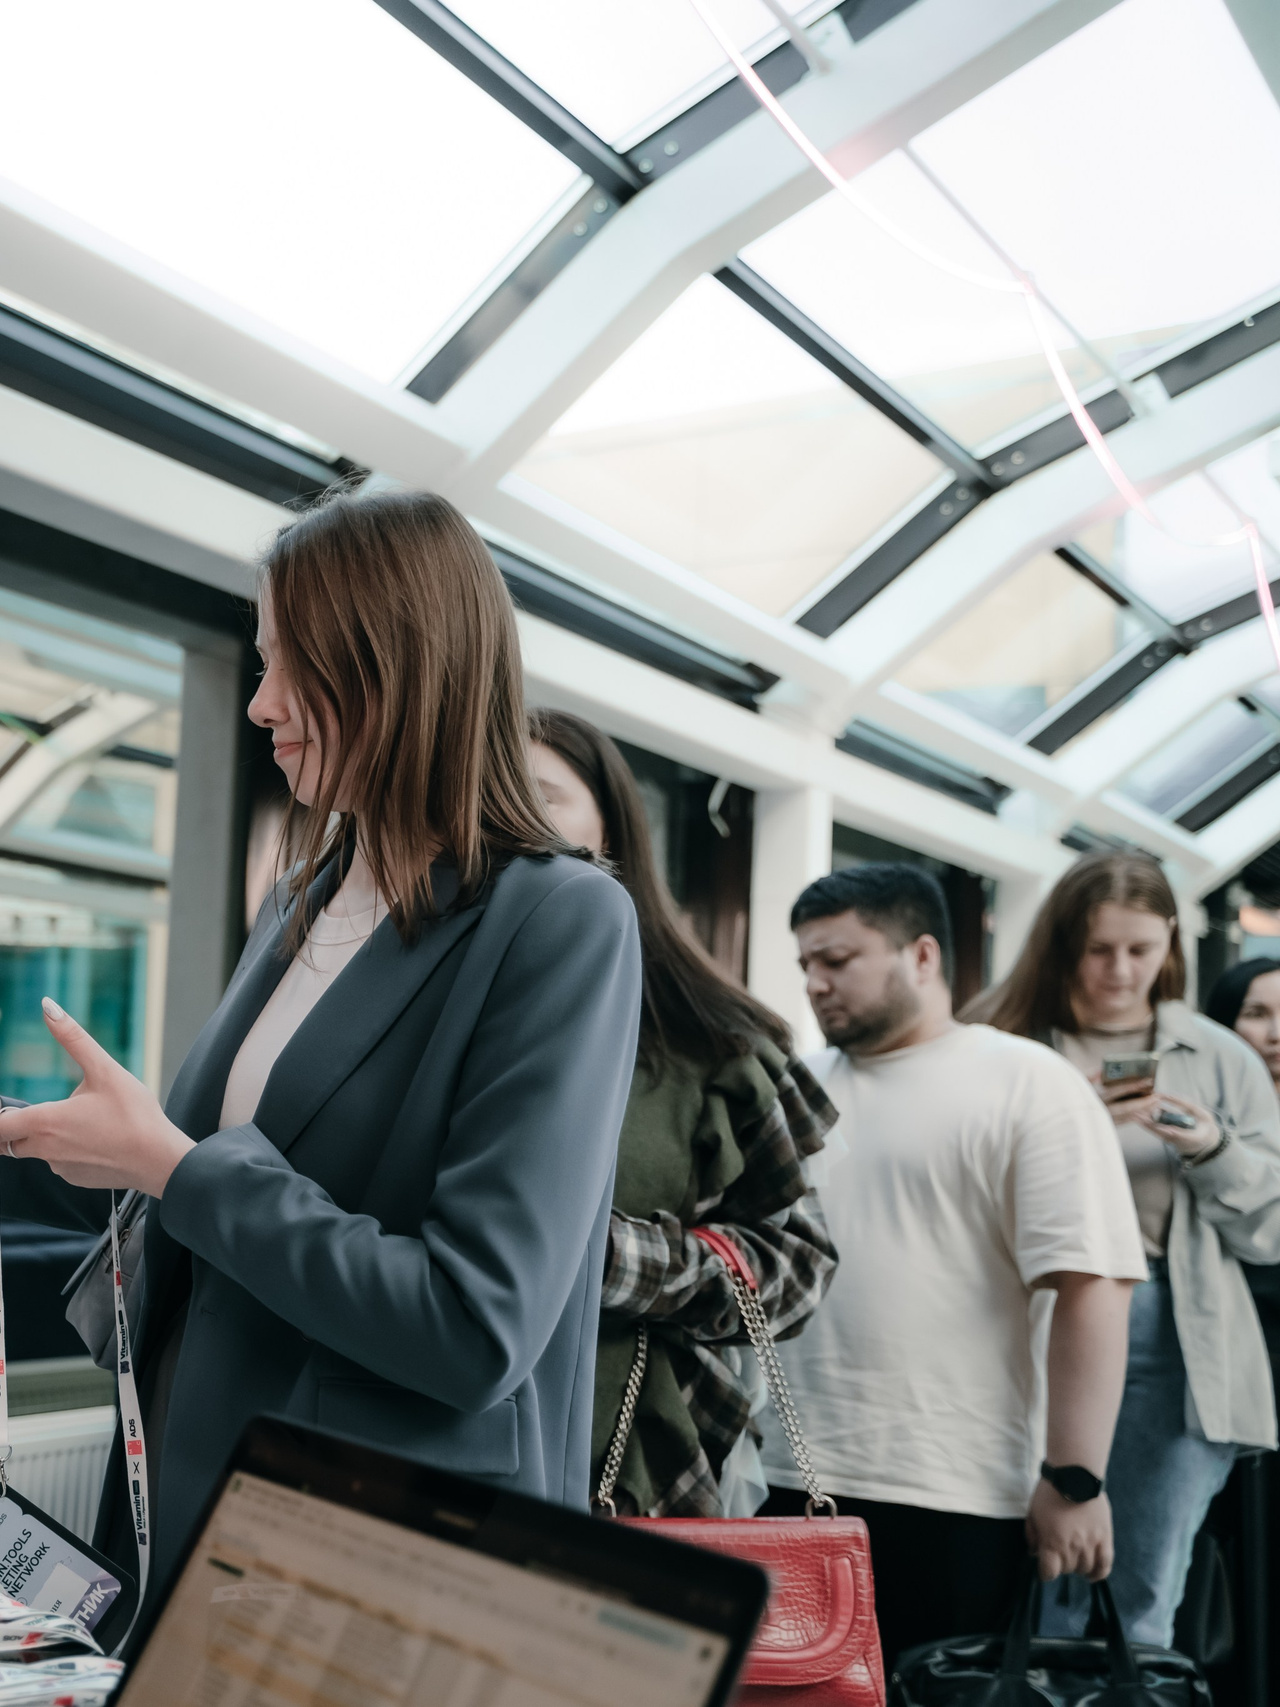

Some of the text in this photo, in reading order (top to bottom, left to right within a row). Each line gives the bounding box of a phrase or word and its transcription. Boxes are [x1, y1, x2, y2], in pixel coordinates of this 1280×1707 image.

[119, 1324, 127, 1360] Vitamin
[129, 1419, 137, 1438] ADS
[133, 1495, 142, 1530] Vitamin
[3, 1553, 29, 1590] ETING
[8, 1542, 51, 1598] NETWORK
